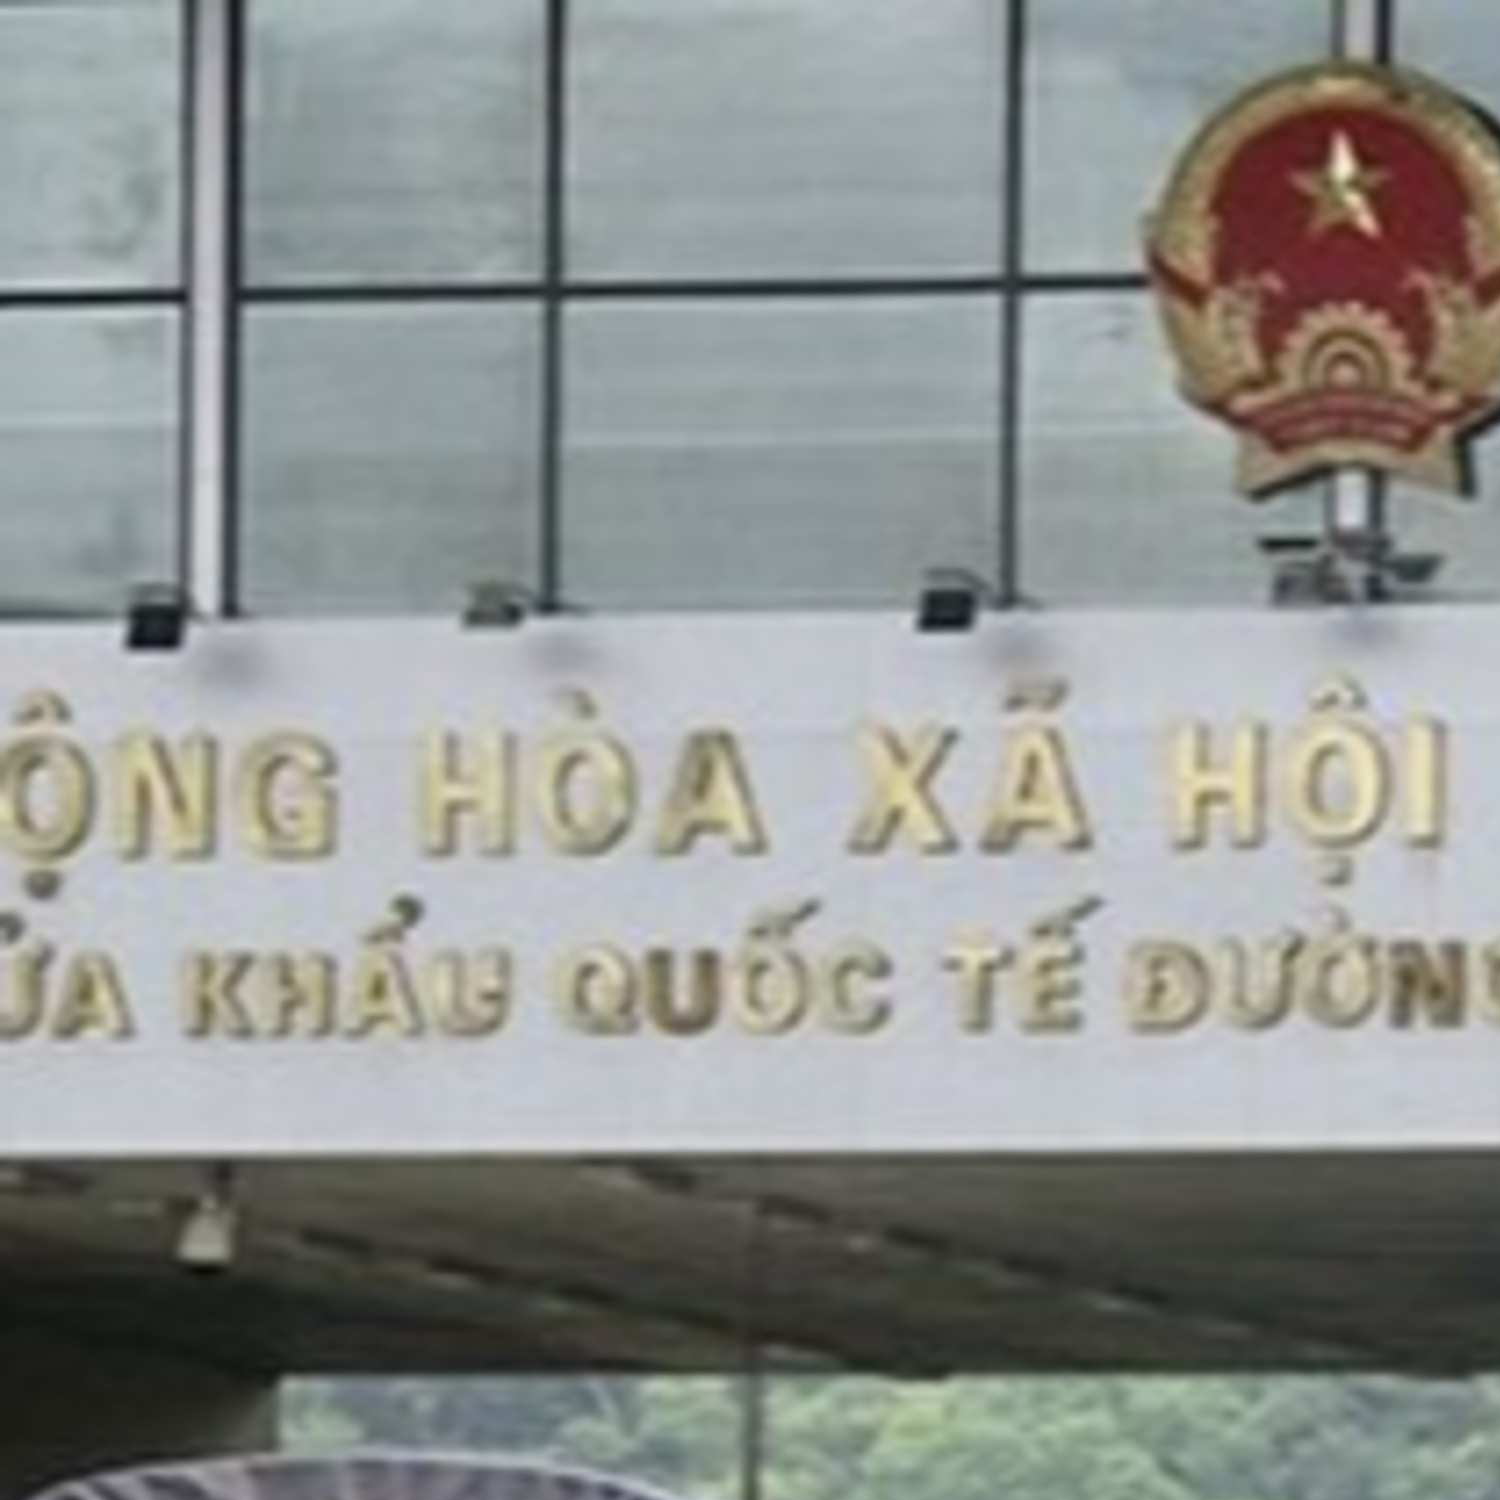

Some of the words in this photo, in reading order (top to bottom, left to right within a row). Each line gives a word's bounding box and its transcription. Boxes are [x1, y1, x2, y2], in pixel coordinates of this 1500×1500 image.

[420, 688, 768, 859] HÒA
[847, 678, 1094, 855] XÃ
[1170, 672, 1446, 887] HỘI
[182, 893, 514, 1040] KHẨU
[558, 898, 894, 1037] QUỐC
[942, 895, 1103, 1035] TẾ
